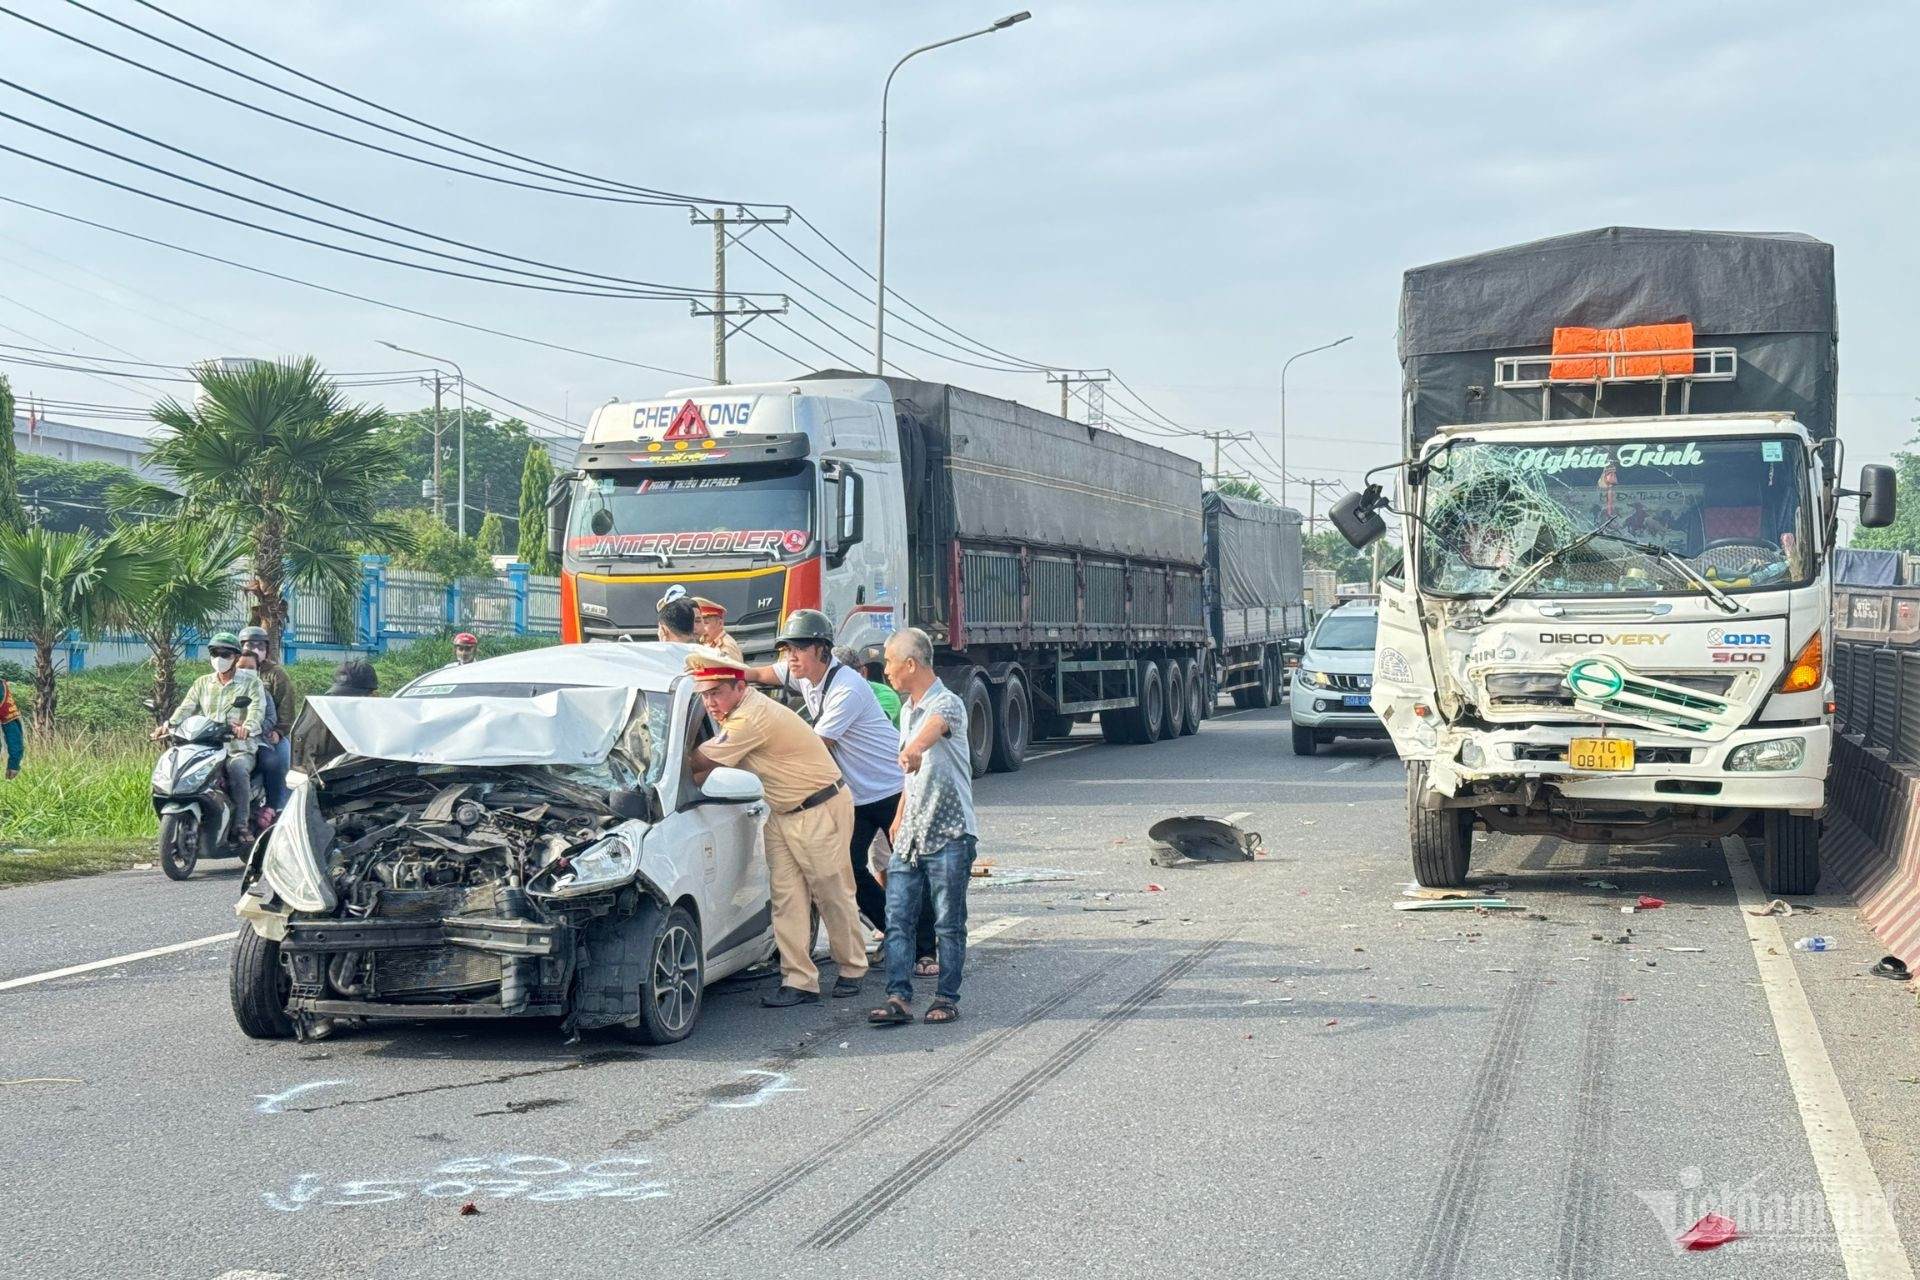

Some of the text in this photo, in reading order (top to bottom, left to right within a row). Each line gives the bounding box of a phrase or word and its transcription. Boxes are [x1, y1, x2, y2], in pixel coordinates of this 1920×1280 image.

[1514, 442, 1704, 475] Nghĩa Trinh
[699, 477, 741, 488] EXPRESS
[591, 530, 785, 557] INTERCOOLER
[758, 597, 773, 608] H7
[1539, 633, 1671, 645] DISCOVERY
[1724, 633, 1771, 646] QDR
[1711, 652, 1766, 663] 500
[1589, 741, 1616, 754] 71C
[1577, 754, 1626, 769] 081.11
